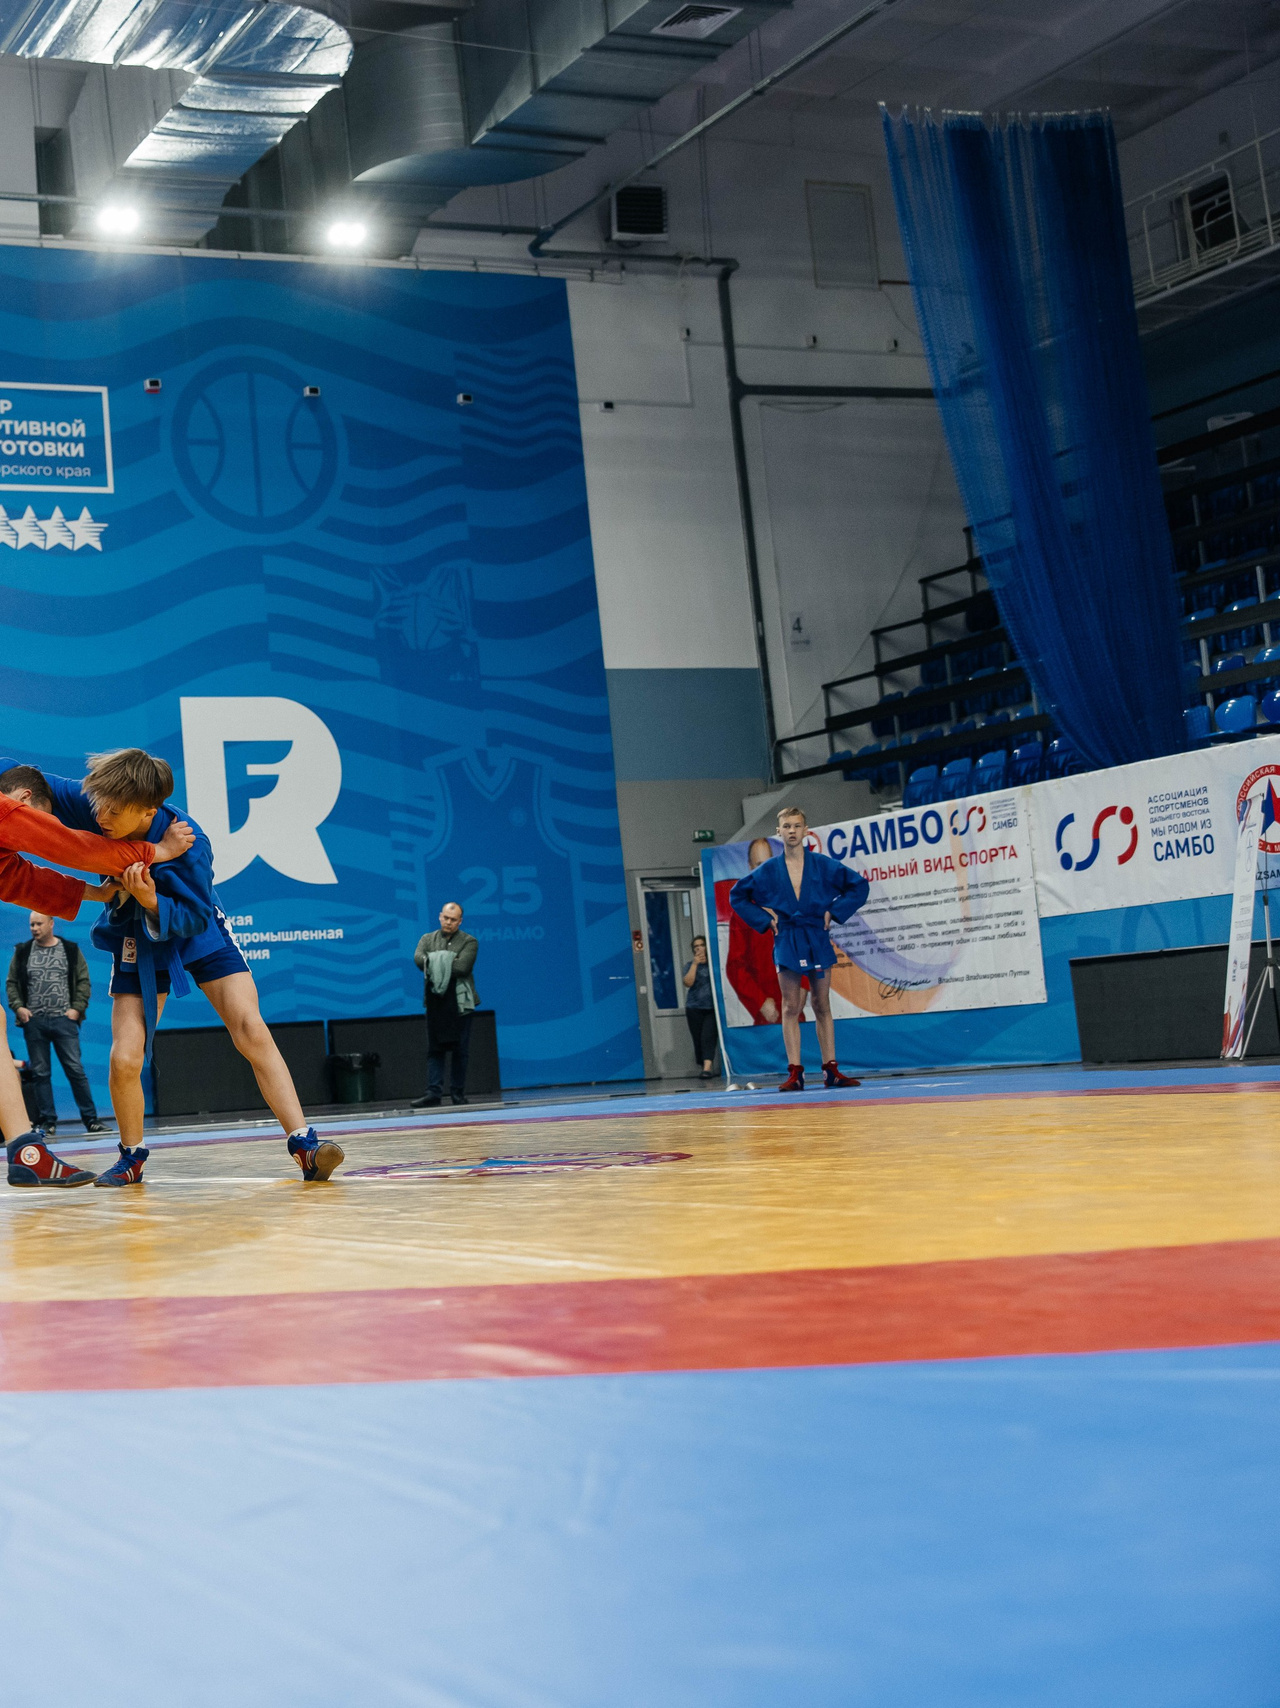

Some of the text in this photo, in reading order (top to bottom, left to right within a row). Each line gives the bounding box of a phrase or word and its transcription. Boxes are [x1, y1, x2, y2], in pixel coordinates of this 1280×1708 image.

[56, 467, 91, 479] края
[792, 617, 803, 633] 4
[1147, 786, 1208, 804] АССОЦИАЦИЯ
[1148, 797, 1209, 815] СПОРТСМЕНОВ
[992, 818, 1018, 831] САМБО
[1149, 808, 1210, 824] ДАЛЬНЕГО ВОСТОКА
[827, 809, 944, 861] САМБО
[1151, 819, 1212, 837] МЫ РОДОМ ИЗ
[1153, 833, 1215, 862] САМБО
[858, 844, 1018, 883] АЛЬНЫЙ ВИД СПОРТА
[458, 865, 543, 916] 25
[234, 928, 344, 947] промышленная
